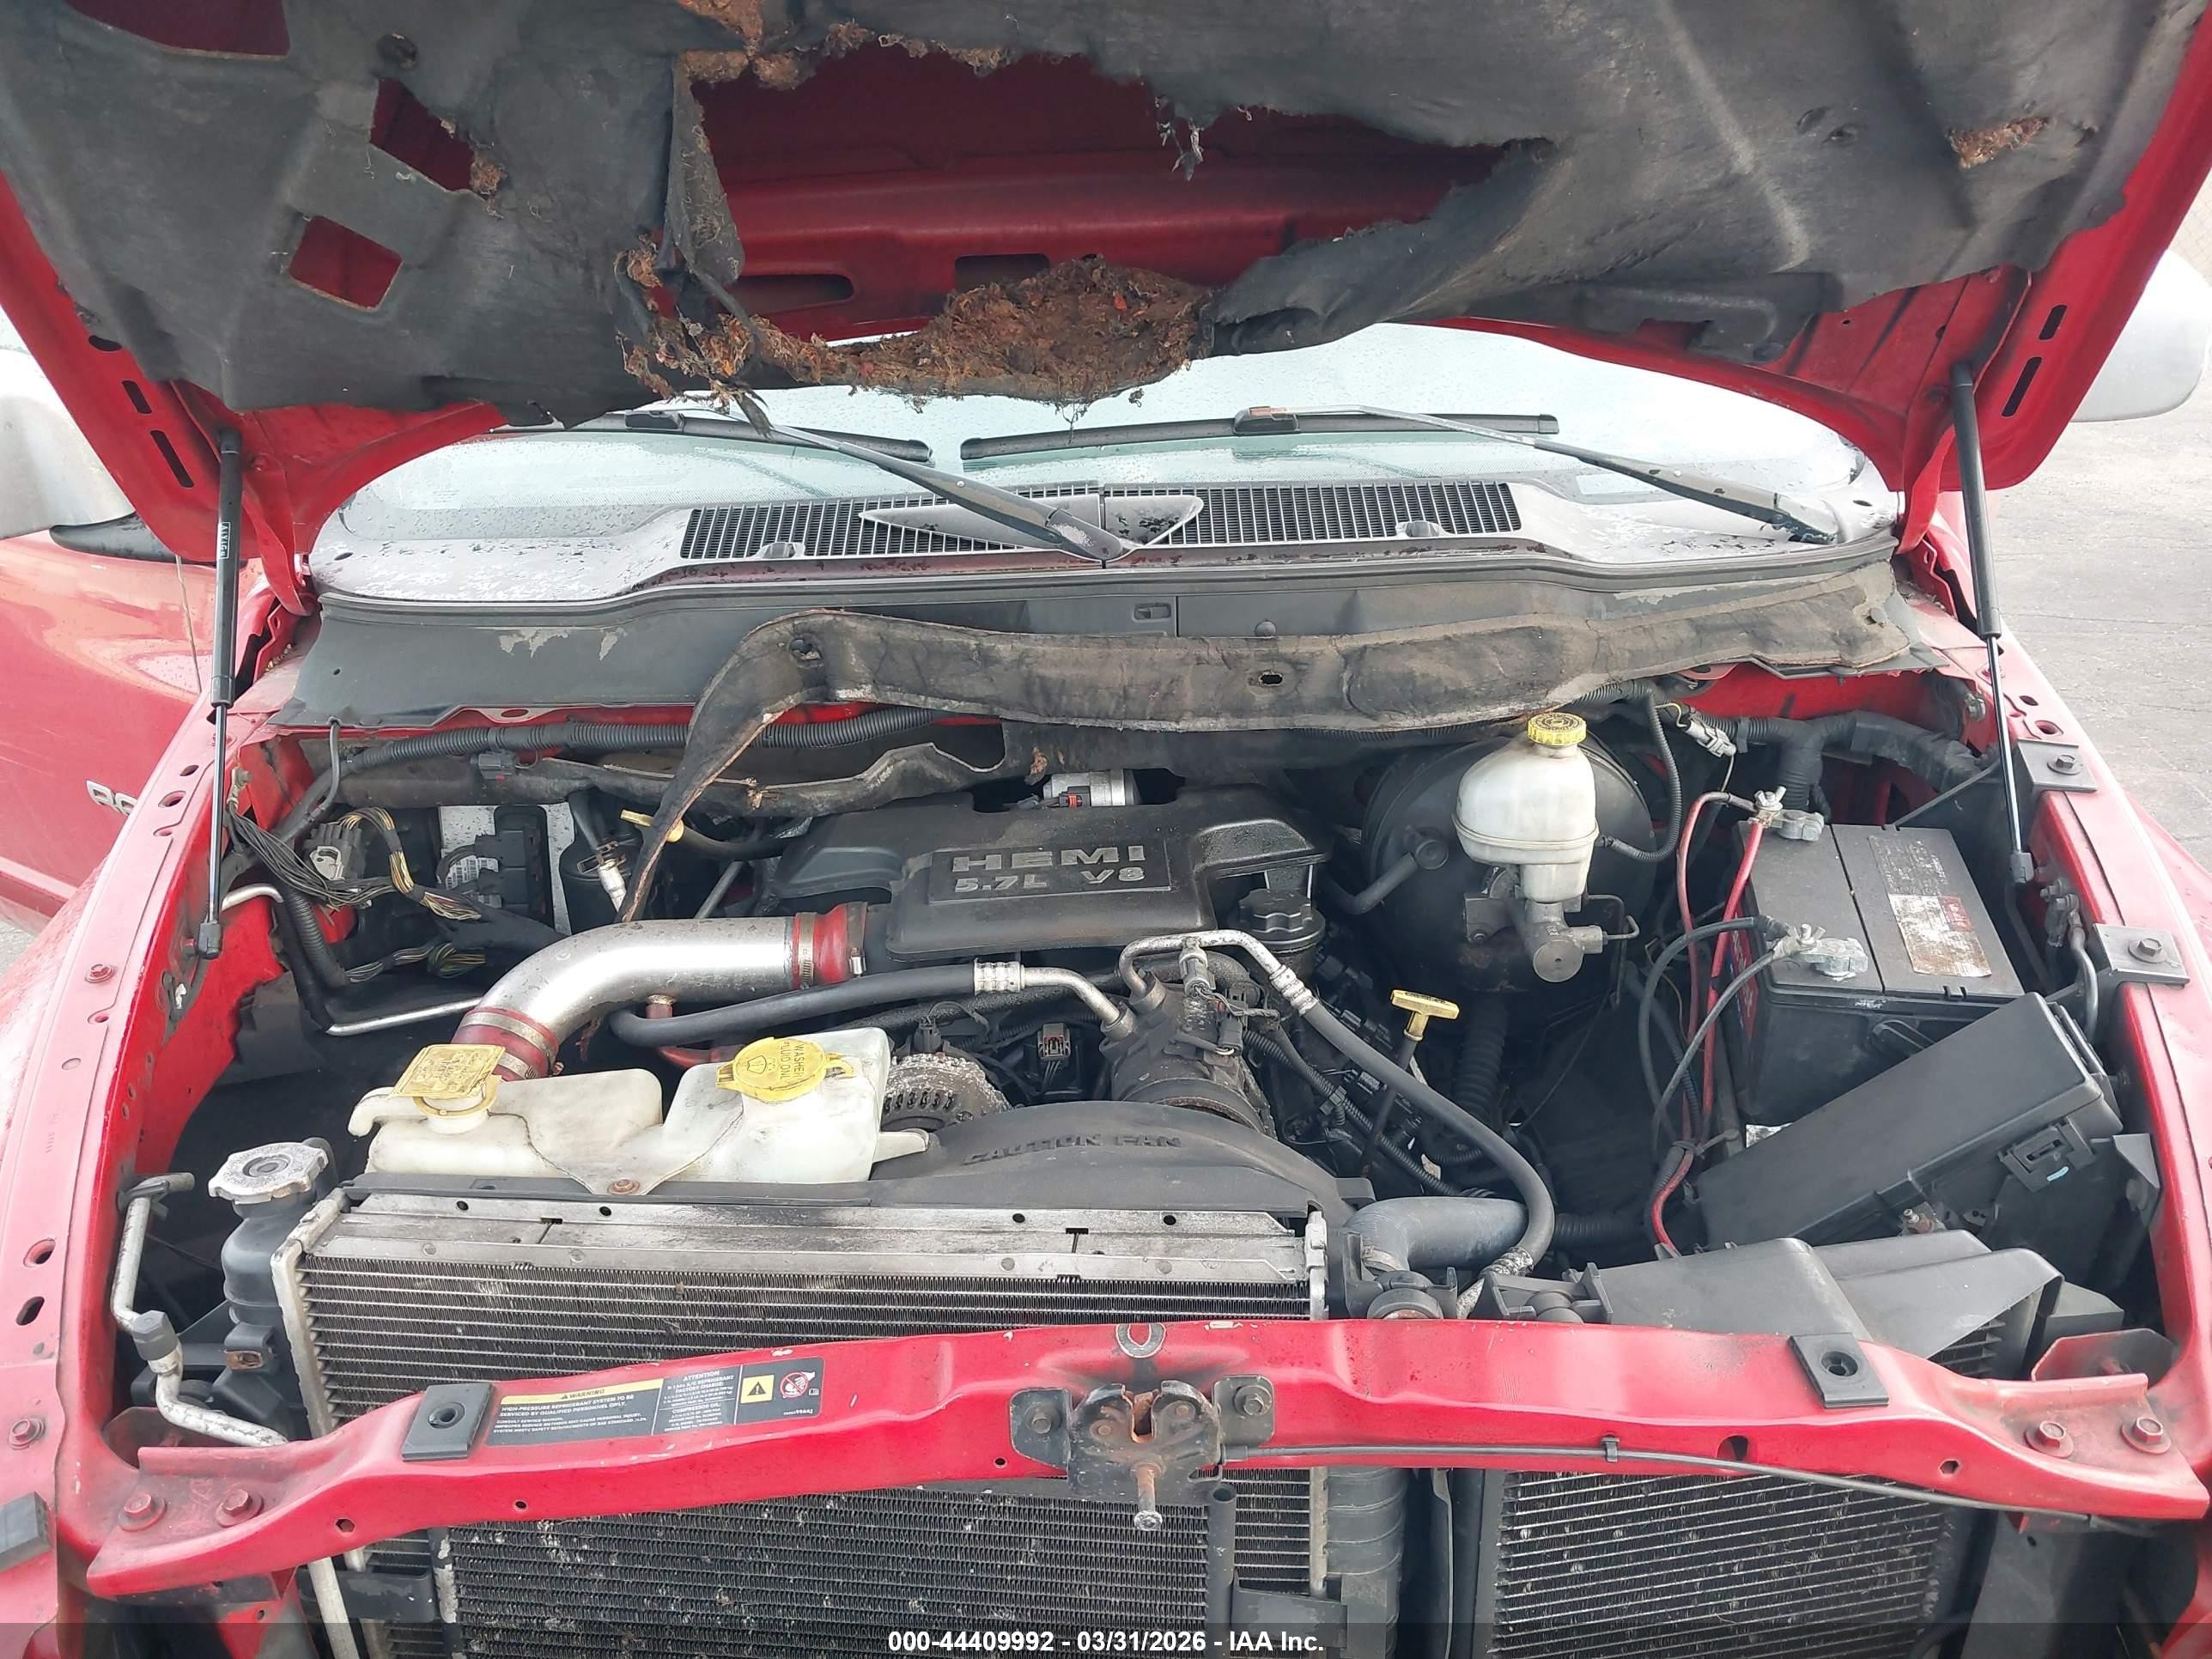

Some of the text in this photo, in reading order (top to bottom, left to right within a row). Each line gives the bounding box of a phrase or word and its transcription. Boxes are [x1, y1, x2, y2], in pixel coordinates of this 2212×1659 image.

[87, 780, 137, 816] RA
[952, 845, 1146, 872] HEMI
[954, 866, 1146, 893] 5.7L V8
[793, 1043, 805, 1078] WASHER
[780, 1065, 790, 1082] ONL
[1115, 1133, 1182, 1147] FAN
[683, 1370, 720, 1382] ATTENTION
[570, 1389, 605, 1398] WARNING
[672, 1404, 709, 1414] COMPRESSOR
